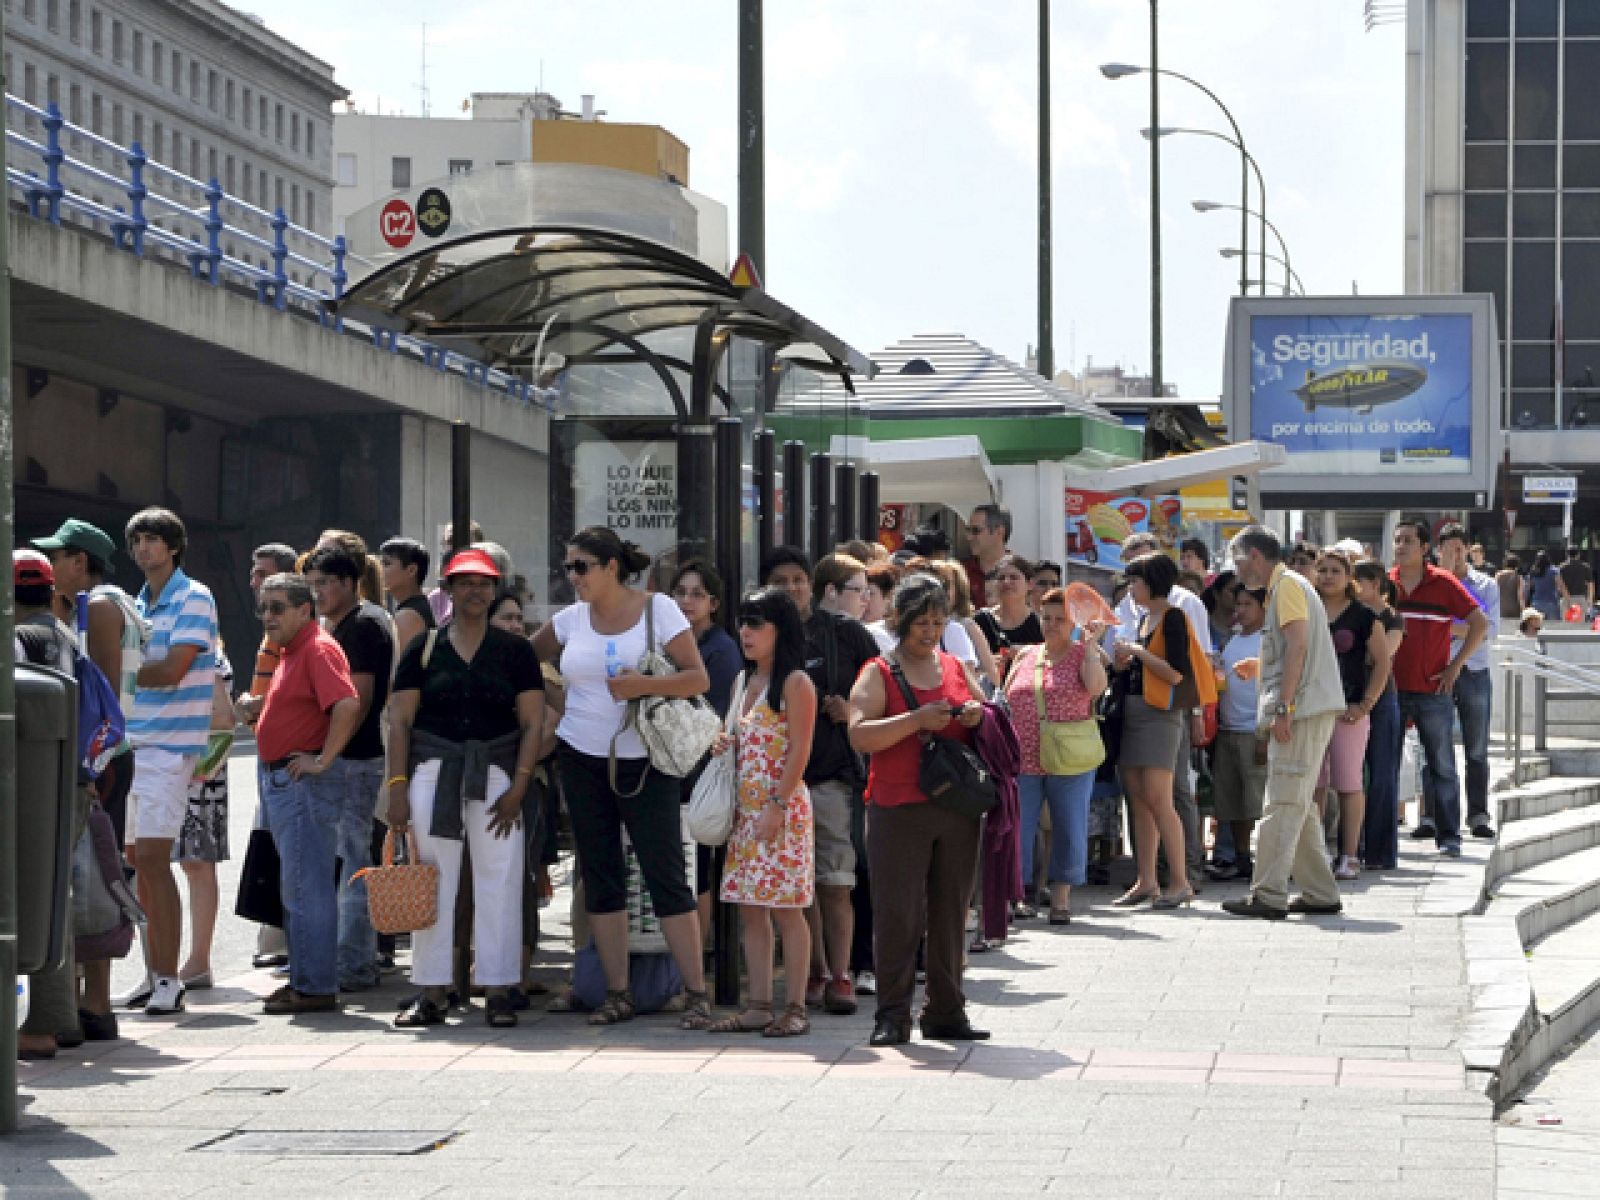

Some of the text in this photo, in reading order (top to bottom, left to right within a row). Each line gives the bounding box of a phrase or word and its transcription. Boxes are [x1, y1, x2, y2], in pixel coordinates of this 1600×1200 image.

[384, 212, 415, 236] C2
[1273, 333, 1436, 366] Seguridad,
[1272, 418, 1436, 438] por encima de todo.
[608, 465, 630, 480] LO
[608, 498, 642, 513] LOS
[608, 514, 630, 528] LO
